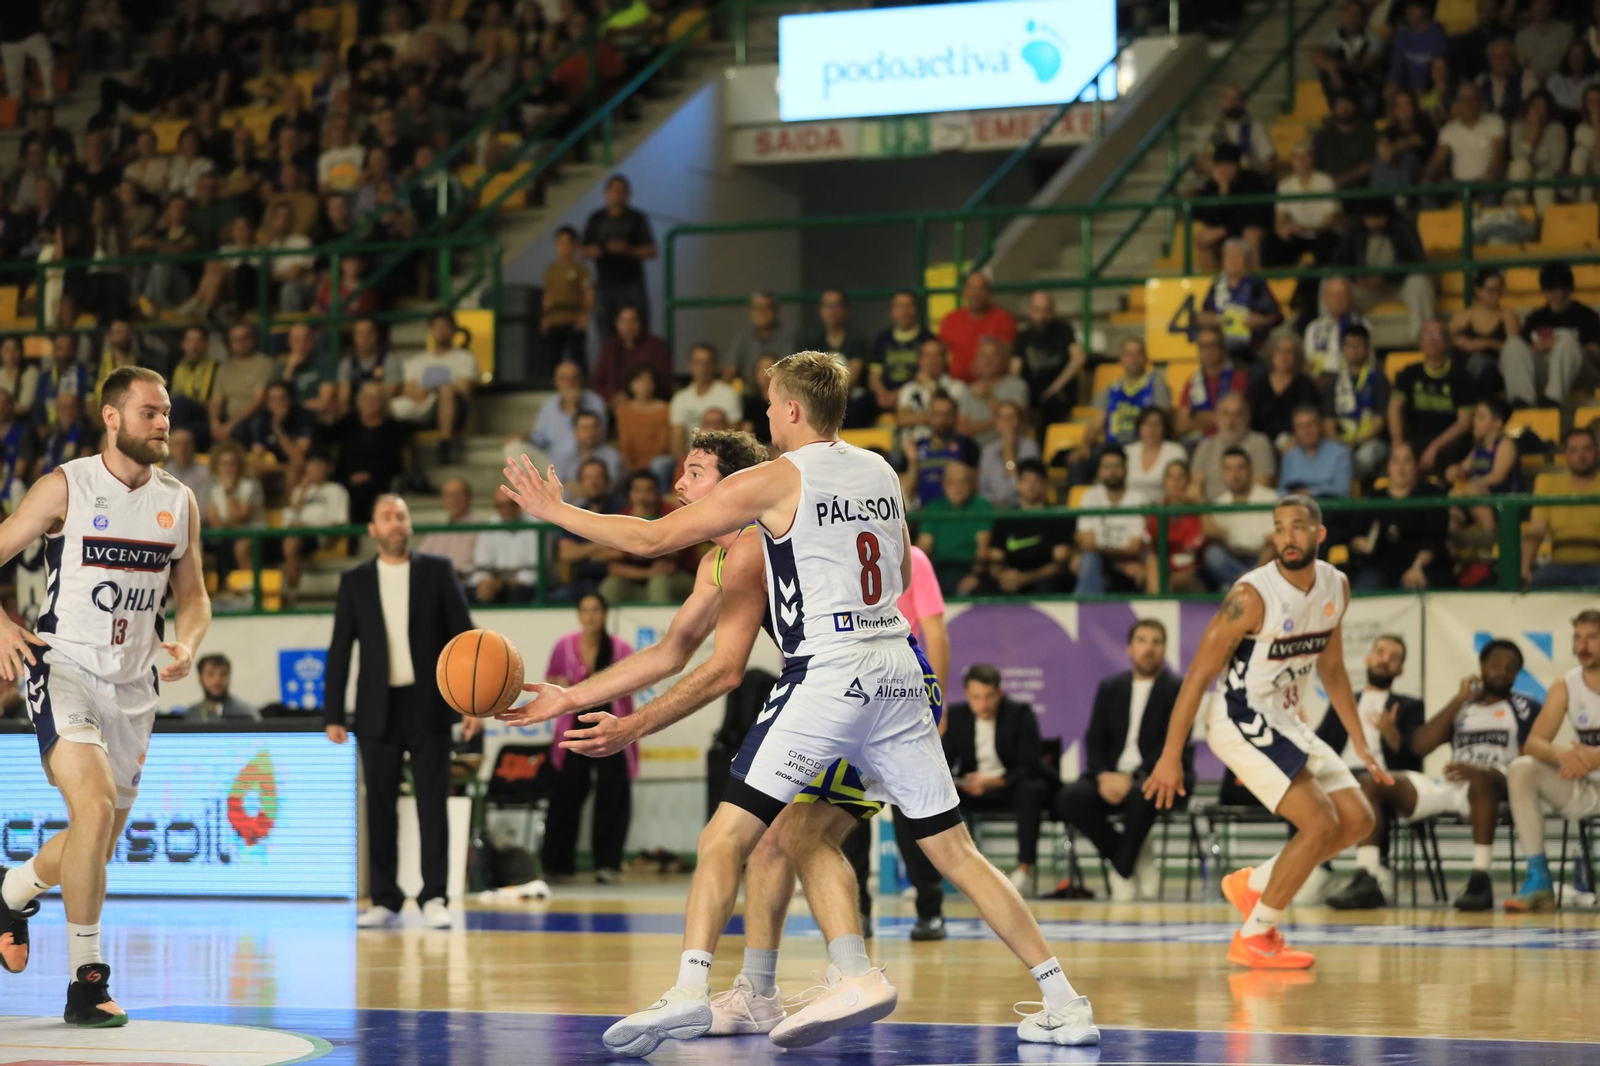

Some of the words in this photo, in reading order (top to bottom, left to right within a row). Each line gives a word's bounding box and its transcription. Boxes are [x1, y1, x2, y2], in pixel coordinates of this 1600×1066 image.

[823, 48, 1009, 98] podoactiva
[1167, 294, 1198, 342] 4
[856, 531, 882, 605] 8
[111, 618, 128, 645] 13
